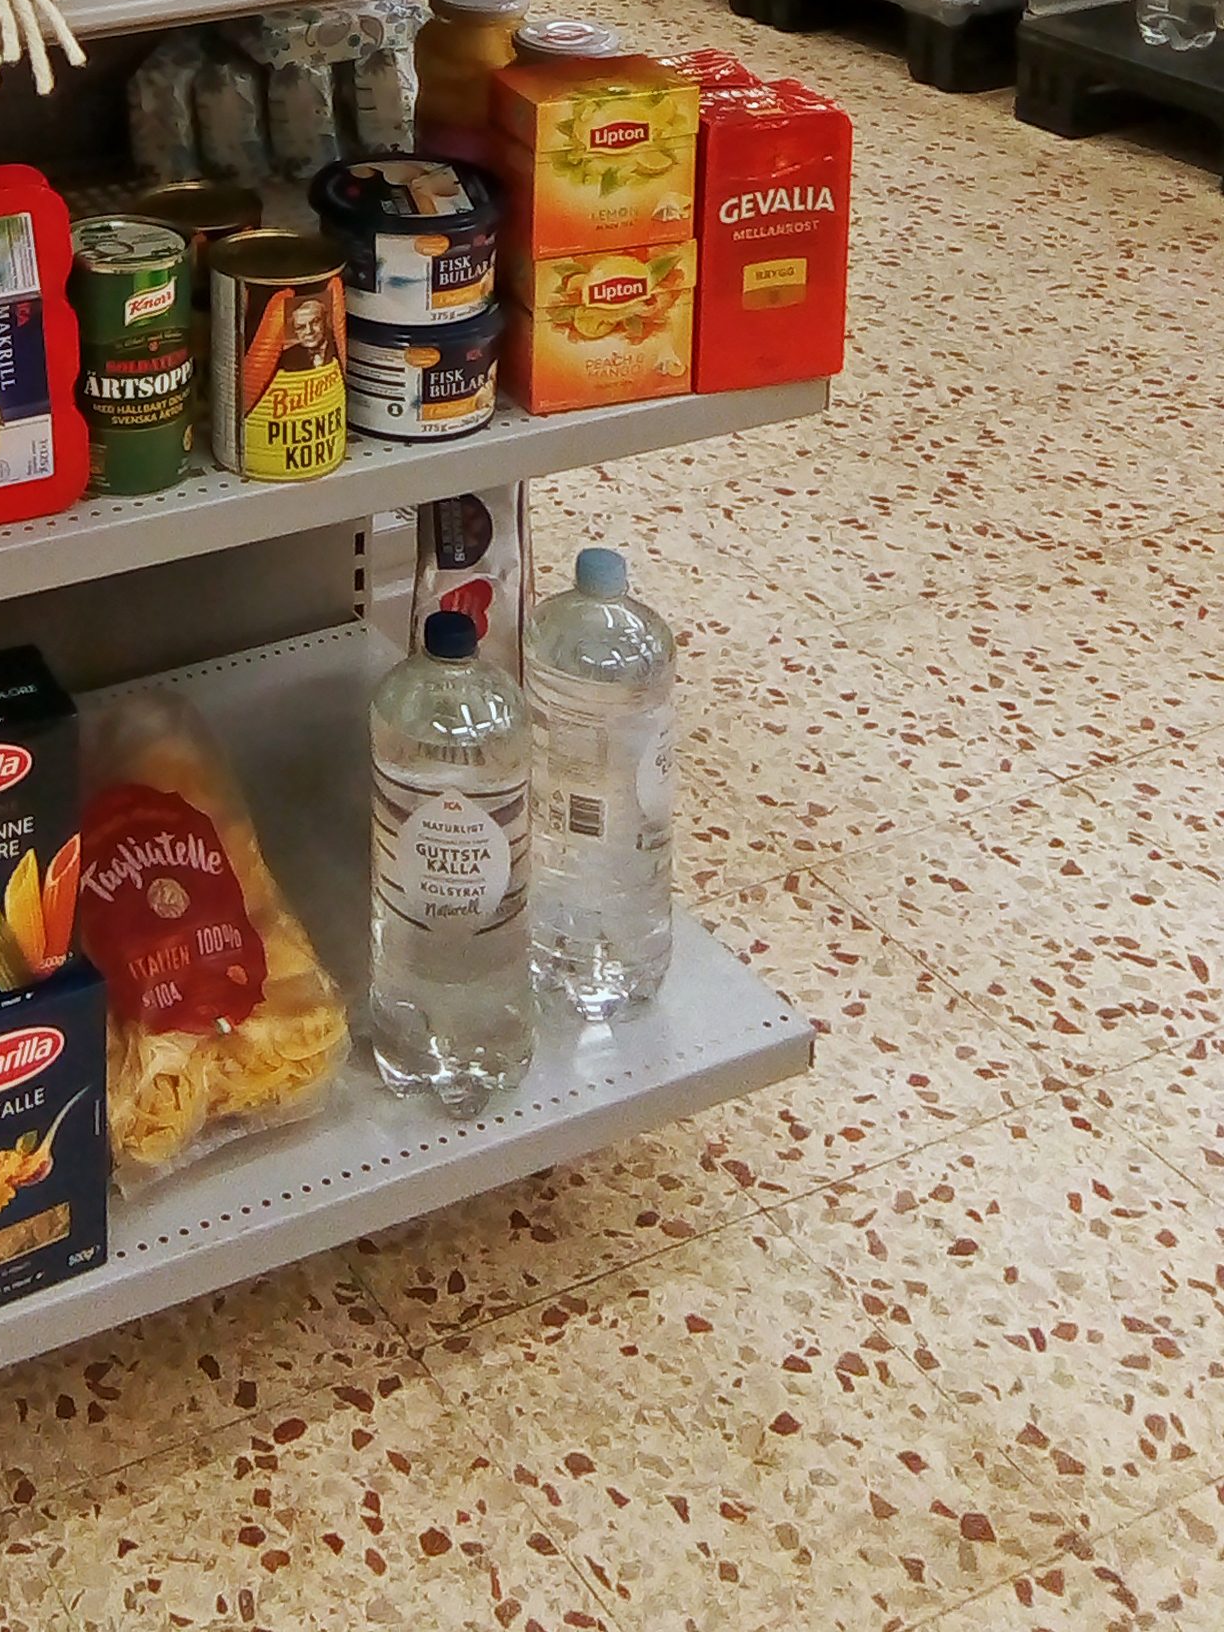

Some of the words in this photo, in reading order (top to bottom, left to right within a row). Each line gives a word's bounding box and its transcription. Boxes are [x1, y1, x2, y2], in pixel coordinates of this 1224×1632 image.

[594, 125, 645, 146] Lipton
[718, 186, 836, 225] GEVALIA
[439, 255, 471, 273] FISK
[593, 279, 644, 302] Lipton
[429, 374, 485, 398] BULLAR
[430, 368, 464, 385] FISK
[267, 407, 343, 446] PILSNER
[284, 436, 337, 471] KORV
[79, 830, 225, 904] Tagliatelle
[416, 843, 491, 862] GUTTSTA
[195, 922, 243, 957] 100%
[127, 941, 192, 981] ITALIEN
